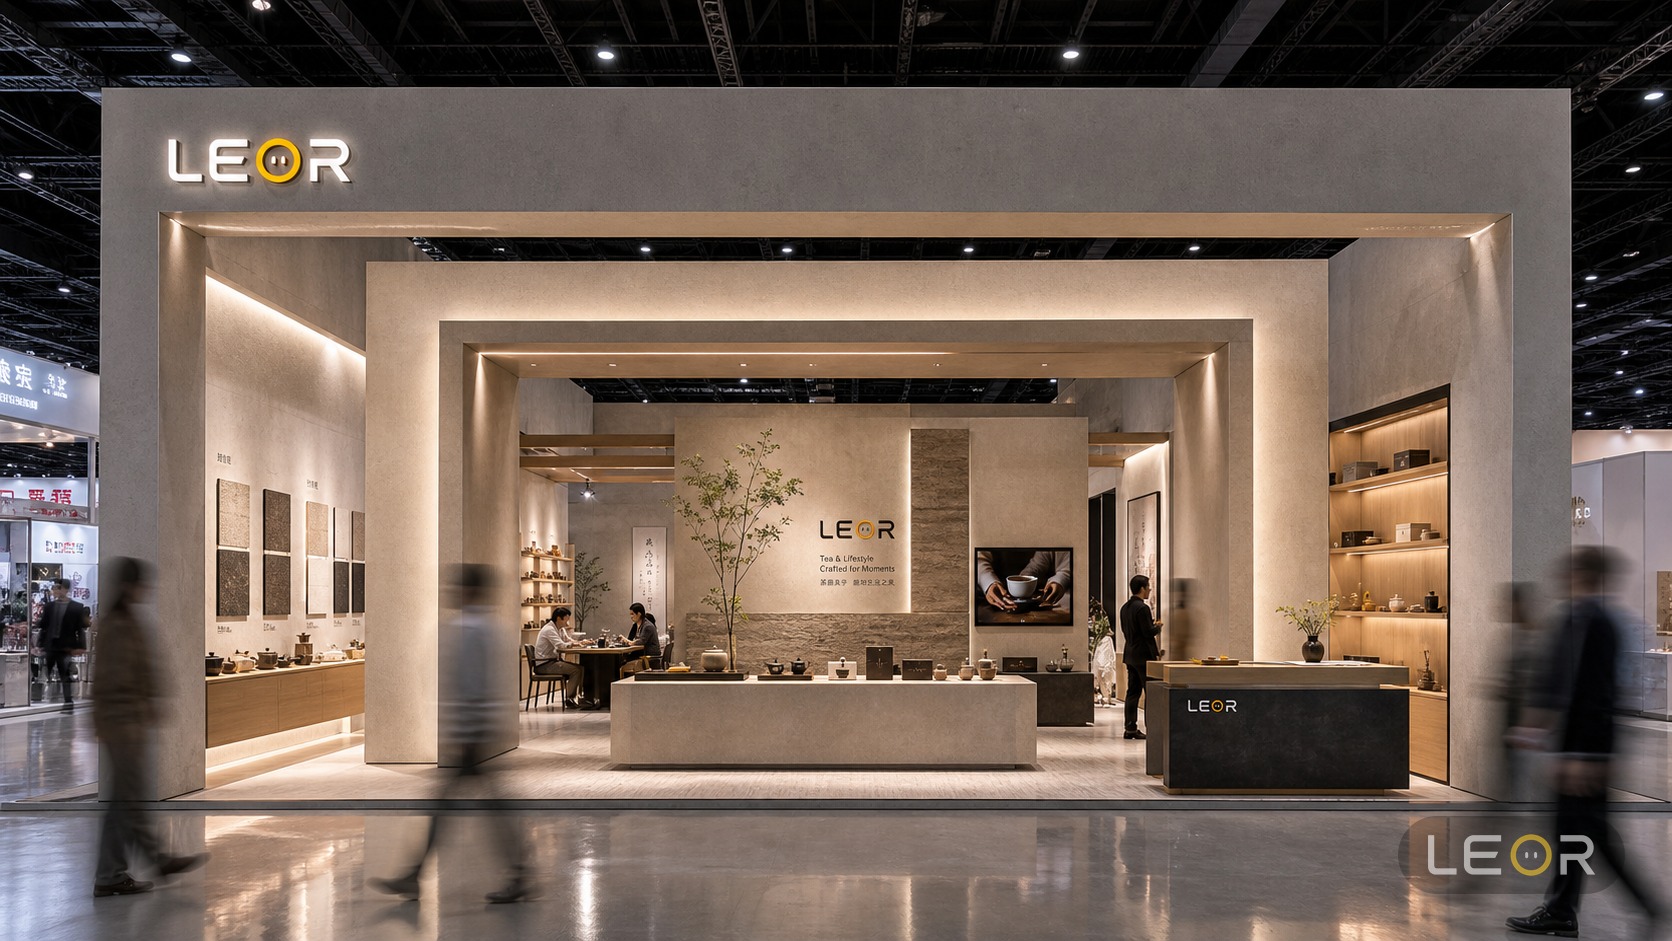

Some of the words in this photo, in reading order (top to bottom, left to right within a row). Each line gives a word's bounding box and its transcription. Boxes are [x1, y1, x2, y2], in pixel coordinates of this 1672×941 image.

[168, 138, 351, 183] LEOR
[820, 519, 895, 539] LEOR
[820, 555, 834, 563] Tea
[835, 555, 841, 563] &
[843, 554, 874, 564] Lifestyle
[820, 565, 848, 573] Crafted
[849, 565, 860, 573] for
[861, 565, 895, 573] Moments
[1187, 699, 1237, 713] LEOR
